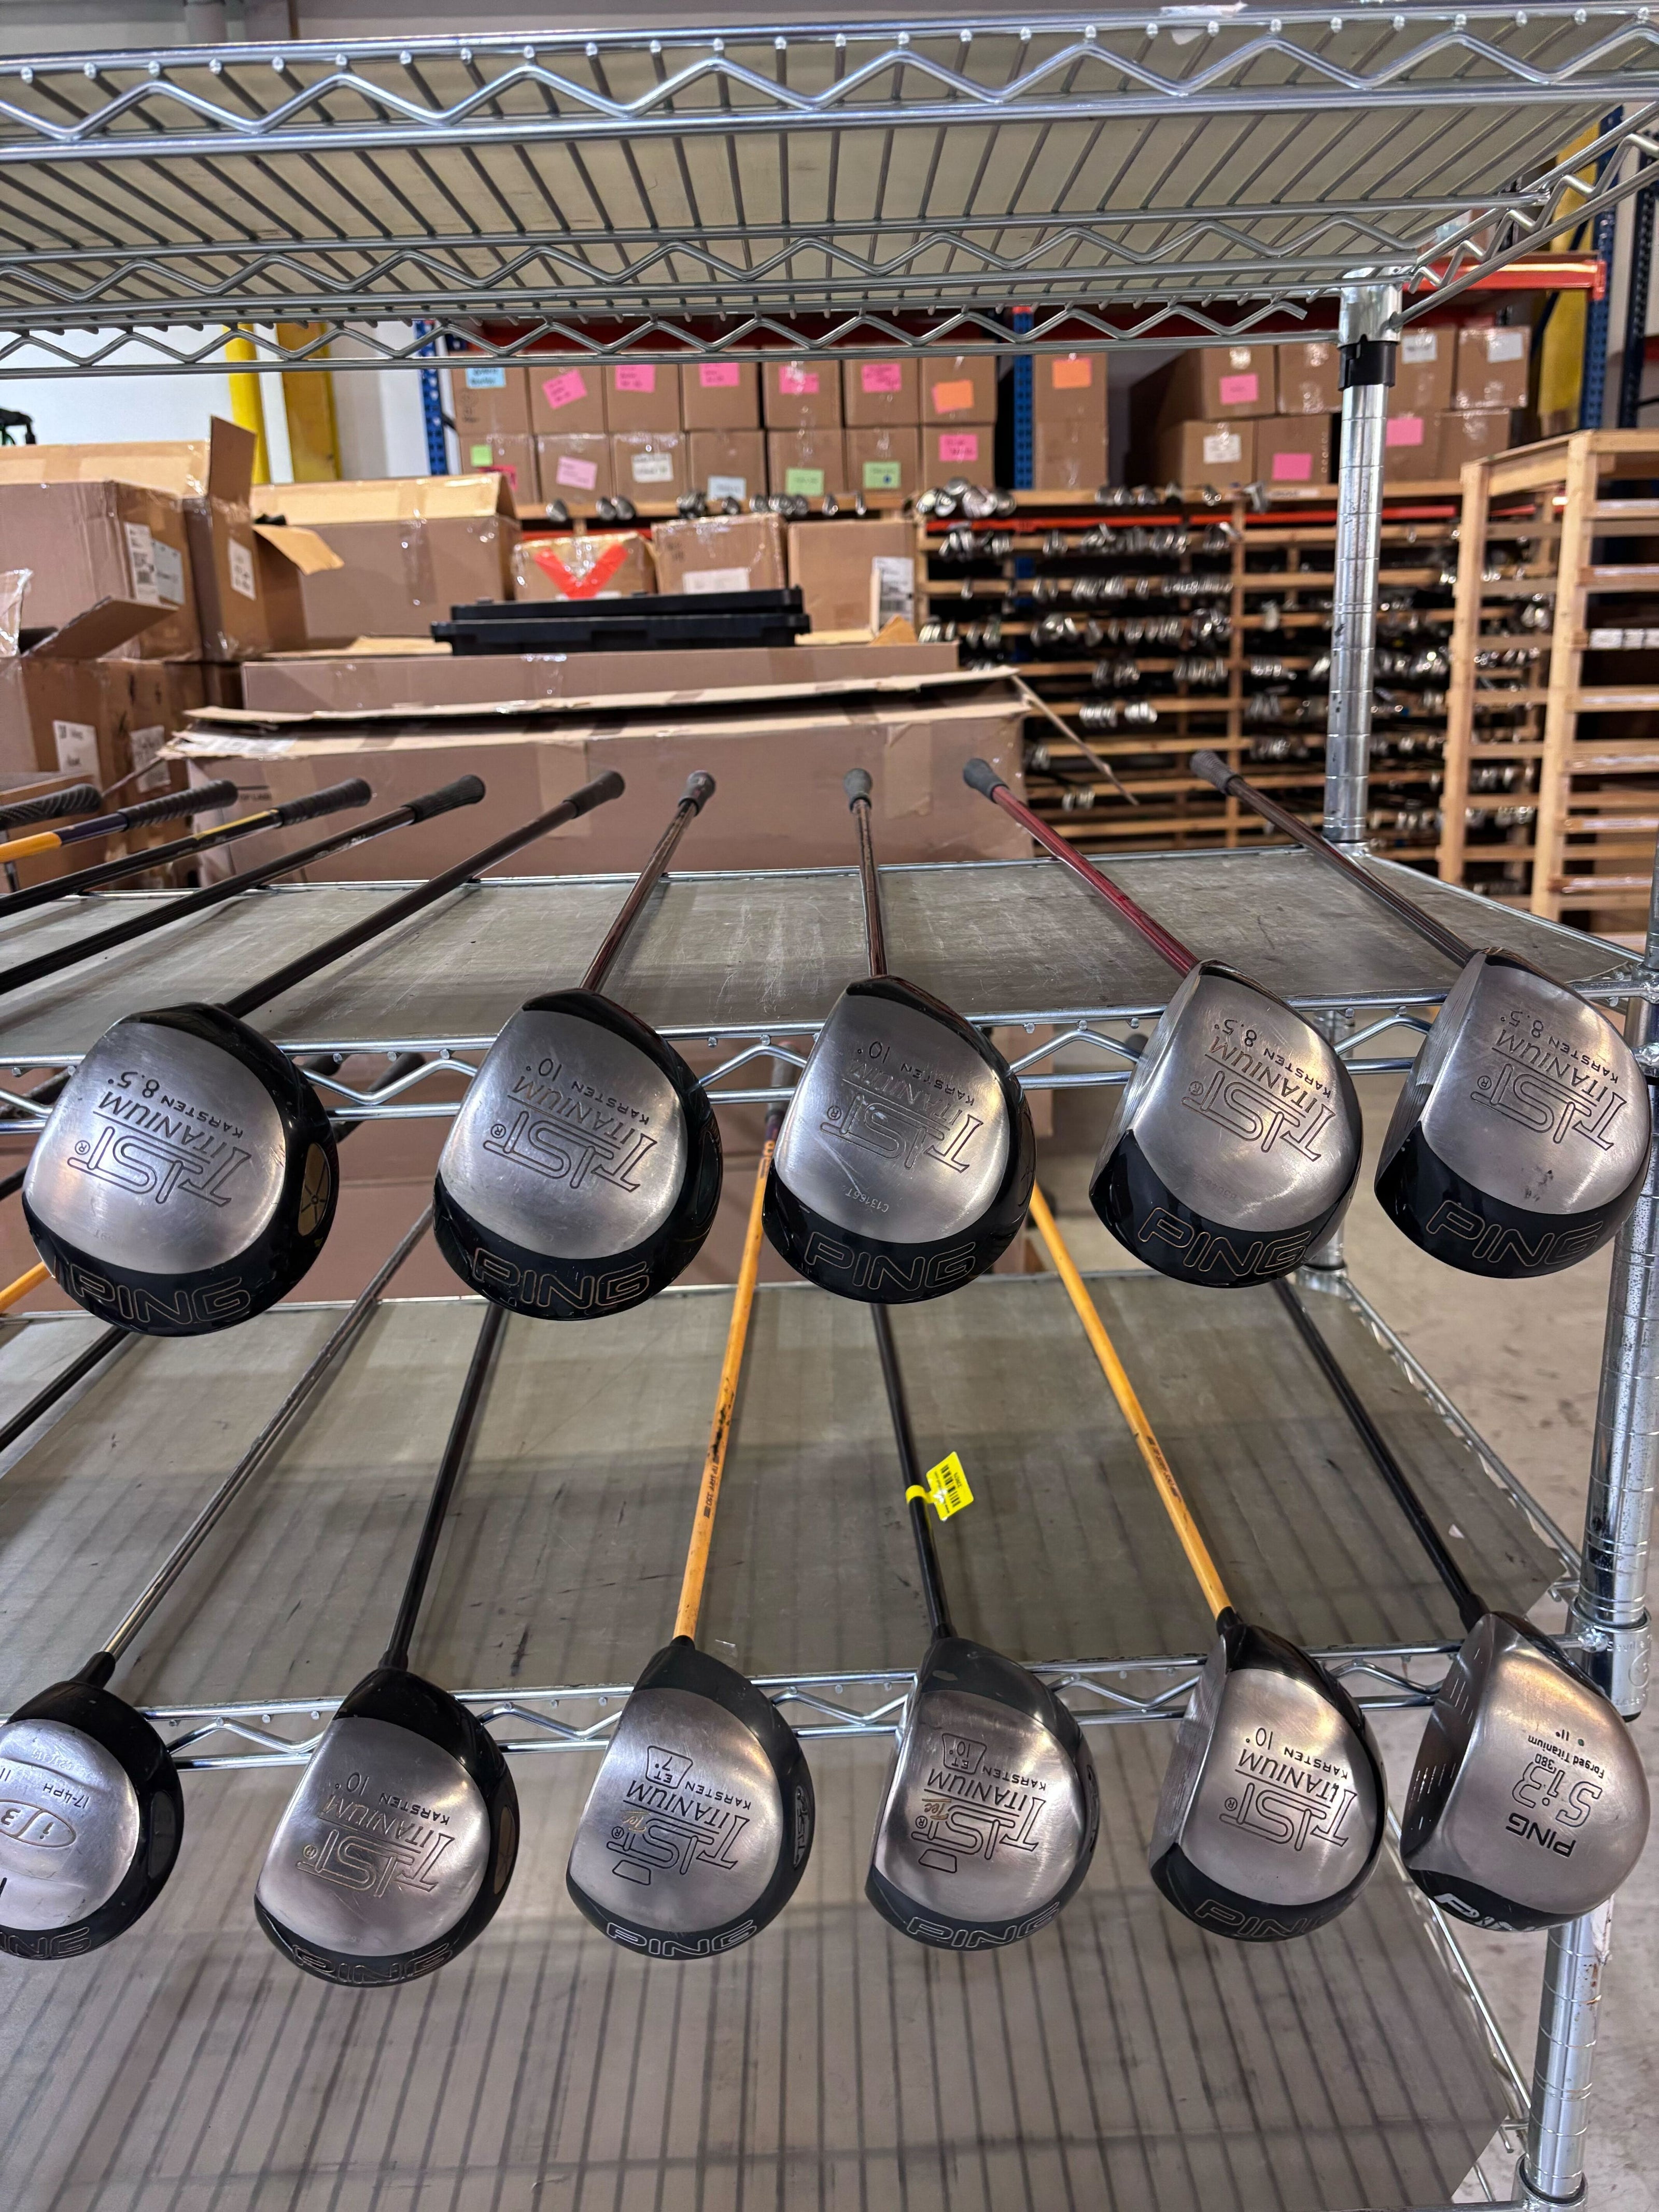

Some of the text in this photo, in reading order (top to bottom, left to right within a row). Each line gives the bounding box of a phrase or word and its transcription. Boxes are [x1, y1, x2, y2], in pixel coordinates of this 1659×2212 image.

[1263, 1047, 1331, 1098] KARSTEN
[1548, 1035, 1619, 1084] KARSTEN
[571, 1080, 650, 1125] KARSTEN
[901, 1062, 975, 1106] KARSTEN
[161, 1095, 243, 1139] KARSTEN
[1138, 1206, 1312, 1277] PING
[1426, 1200, 1604, 1266] PING
[472, 1247, 650, 1309] PING
[804, 1231, 976, 1291] PING
[71, 1258, 251, 1325] PING
[653, 1772, 673, 1784] ET
[951, 1758, 970, 1769] ET
[982, 1765, 1046, 1791] KARSTEN
[1284, 1745, 1348, 1780] KARSTEN
[1528, 1734, 1605, 1780] Forged Titanium
[1535, 1753, 1559, 1770] 380
[378, 1793, 451, 1825] KARSTEN
[684, 1781, 752, 1810] KARSTEN
[1506, 1812, 1576, 1857] PING
[606, 1919, 757, 1956] PING
[906, 1901, 1060, 1948] PING
[293, 1942, 453, 1984] PING
